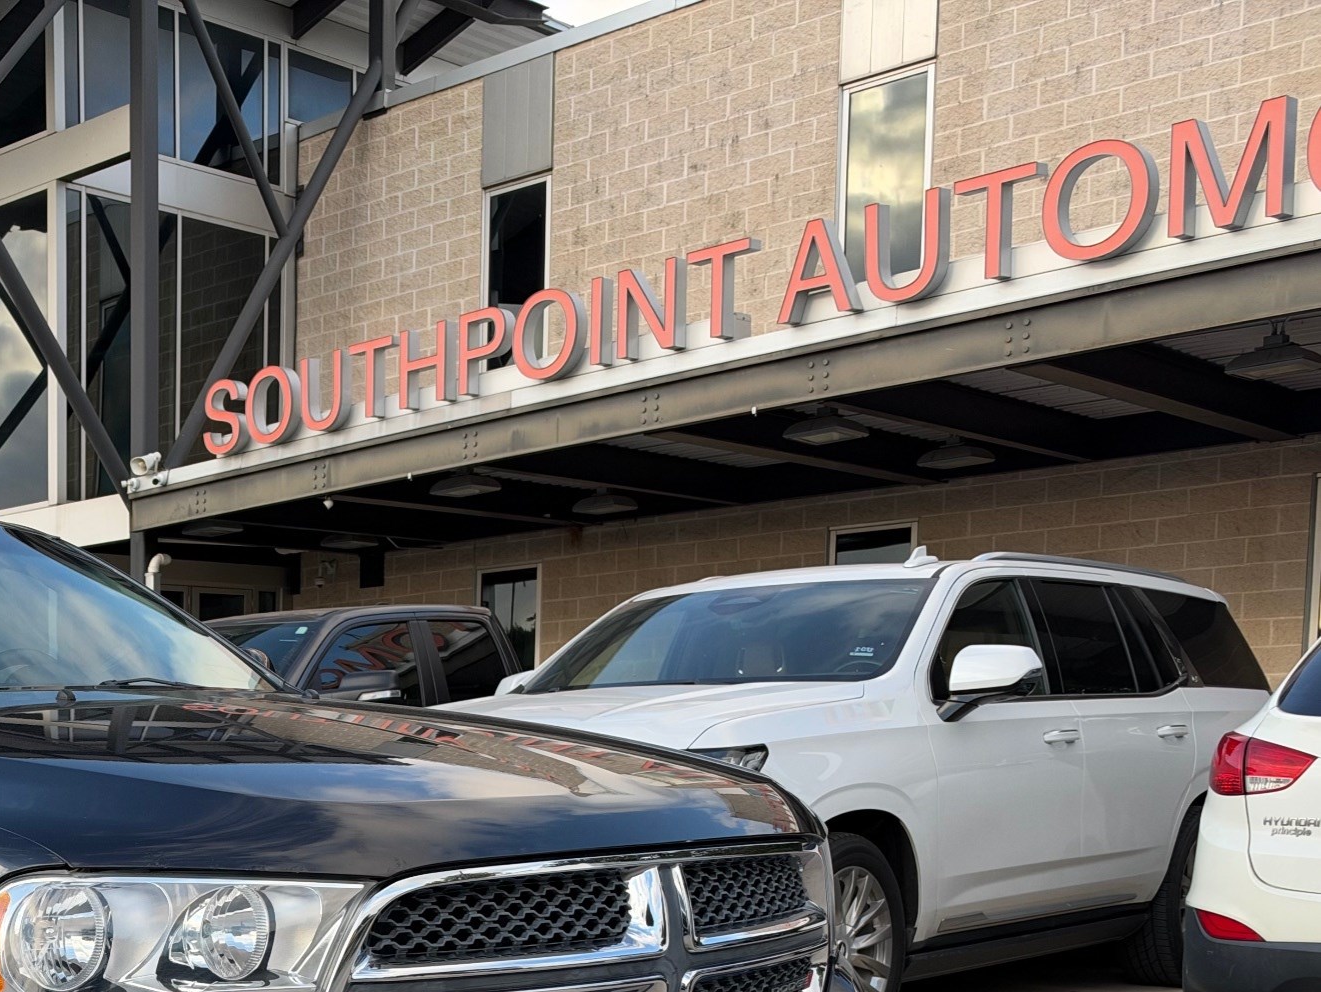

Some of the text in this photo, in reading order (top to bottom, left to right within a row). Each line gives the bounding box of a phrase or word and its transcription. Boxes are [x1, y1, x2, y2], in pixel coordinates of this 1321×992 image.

[203, 94, 1321, 456] SOUTHPOINT AUTOM
[1262, 816, 1321, 828] HYUNDAI
